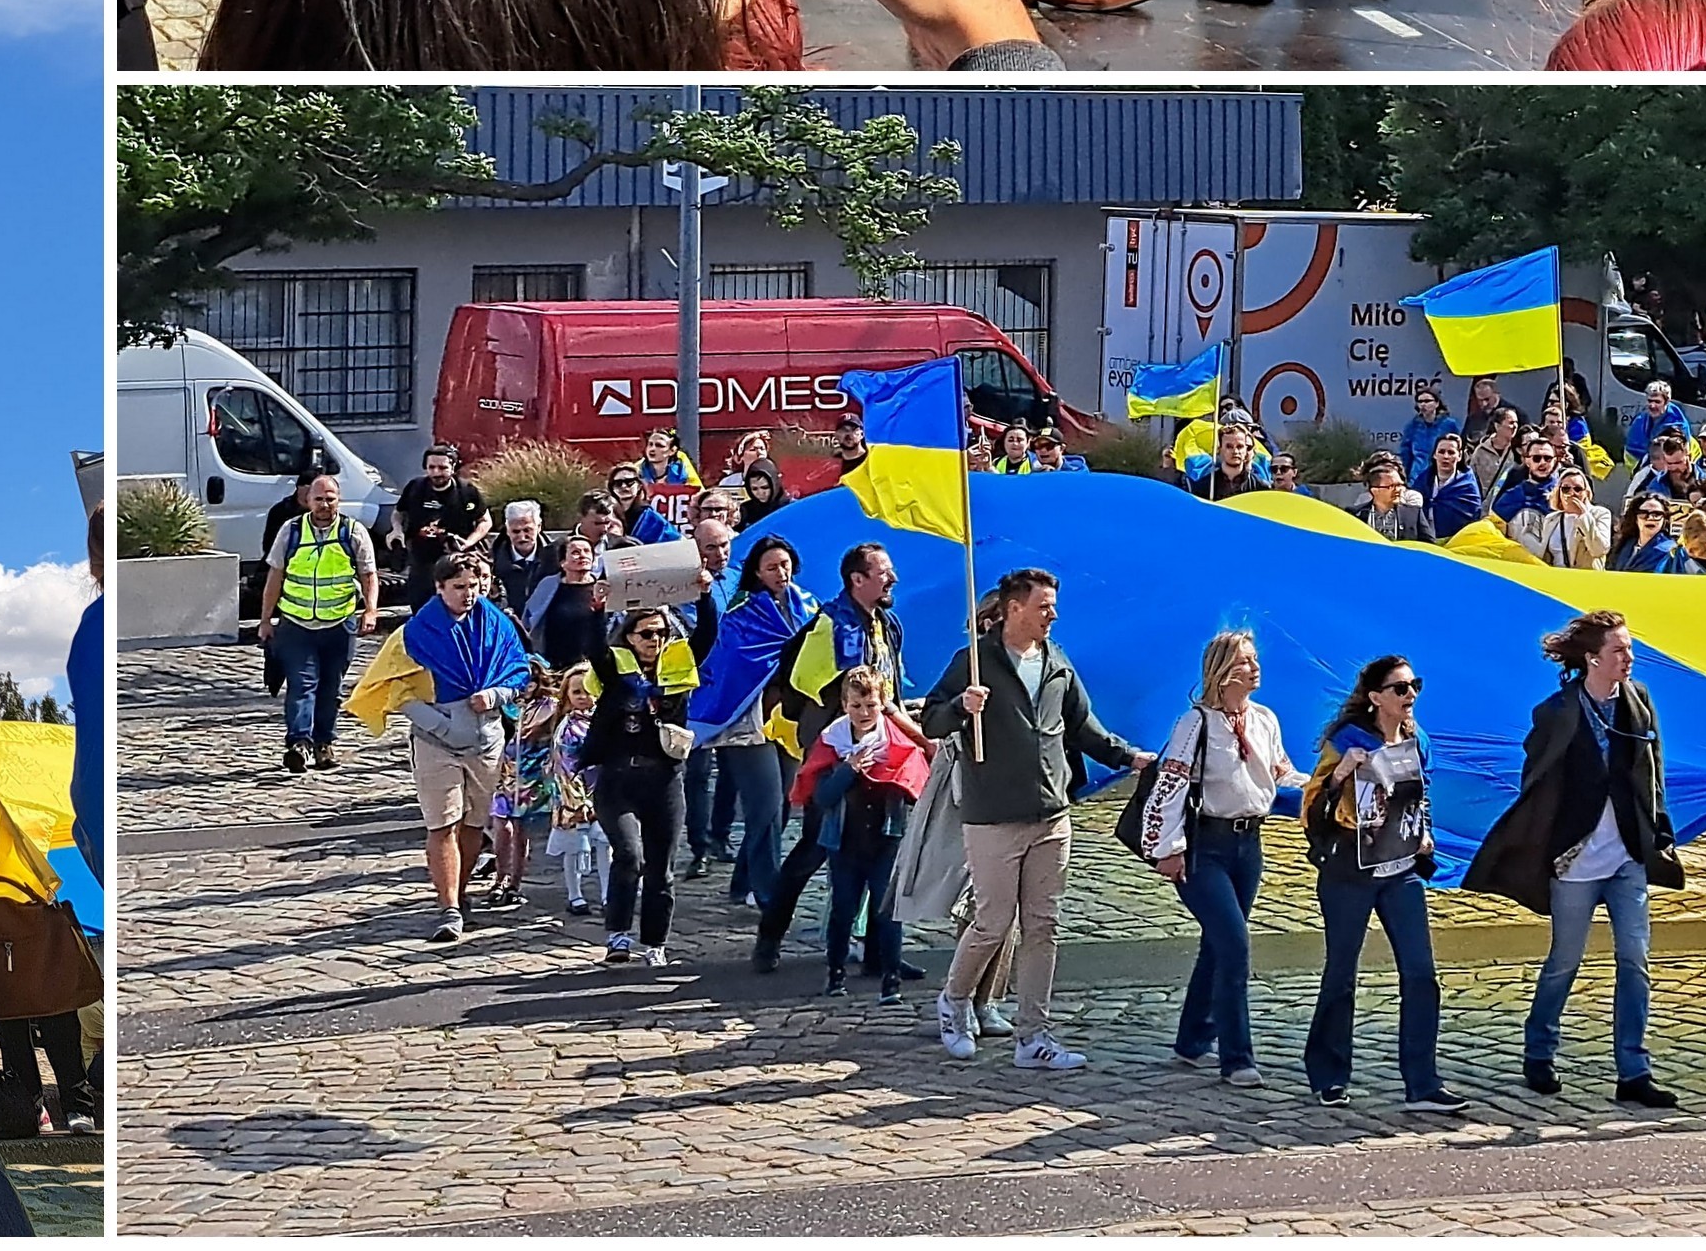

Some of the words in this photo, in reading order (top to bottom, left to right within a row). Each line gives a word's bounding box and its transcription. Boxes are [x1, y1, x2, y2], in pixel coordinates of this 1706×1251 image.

[1127, 252, 1138, 264] TU
[1351, 302, 1406, 327] Miło
[1349, 338, 1390, 368] Cię
[641, 375, 849, 415] DOMES
[1108, 371, 1134, 396] exp
